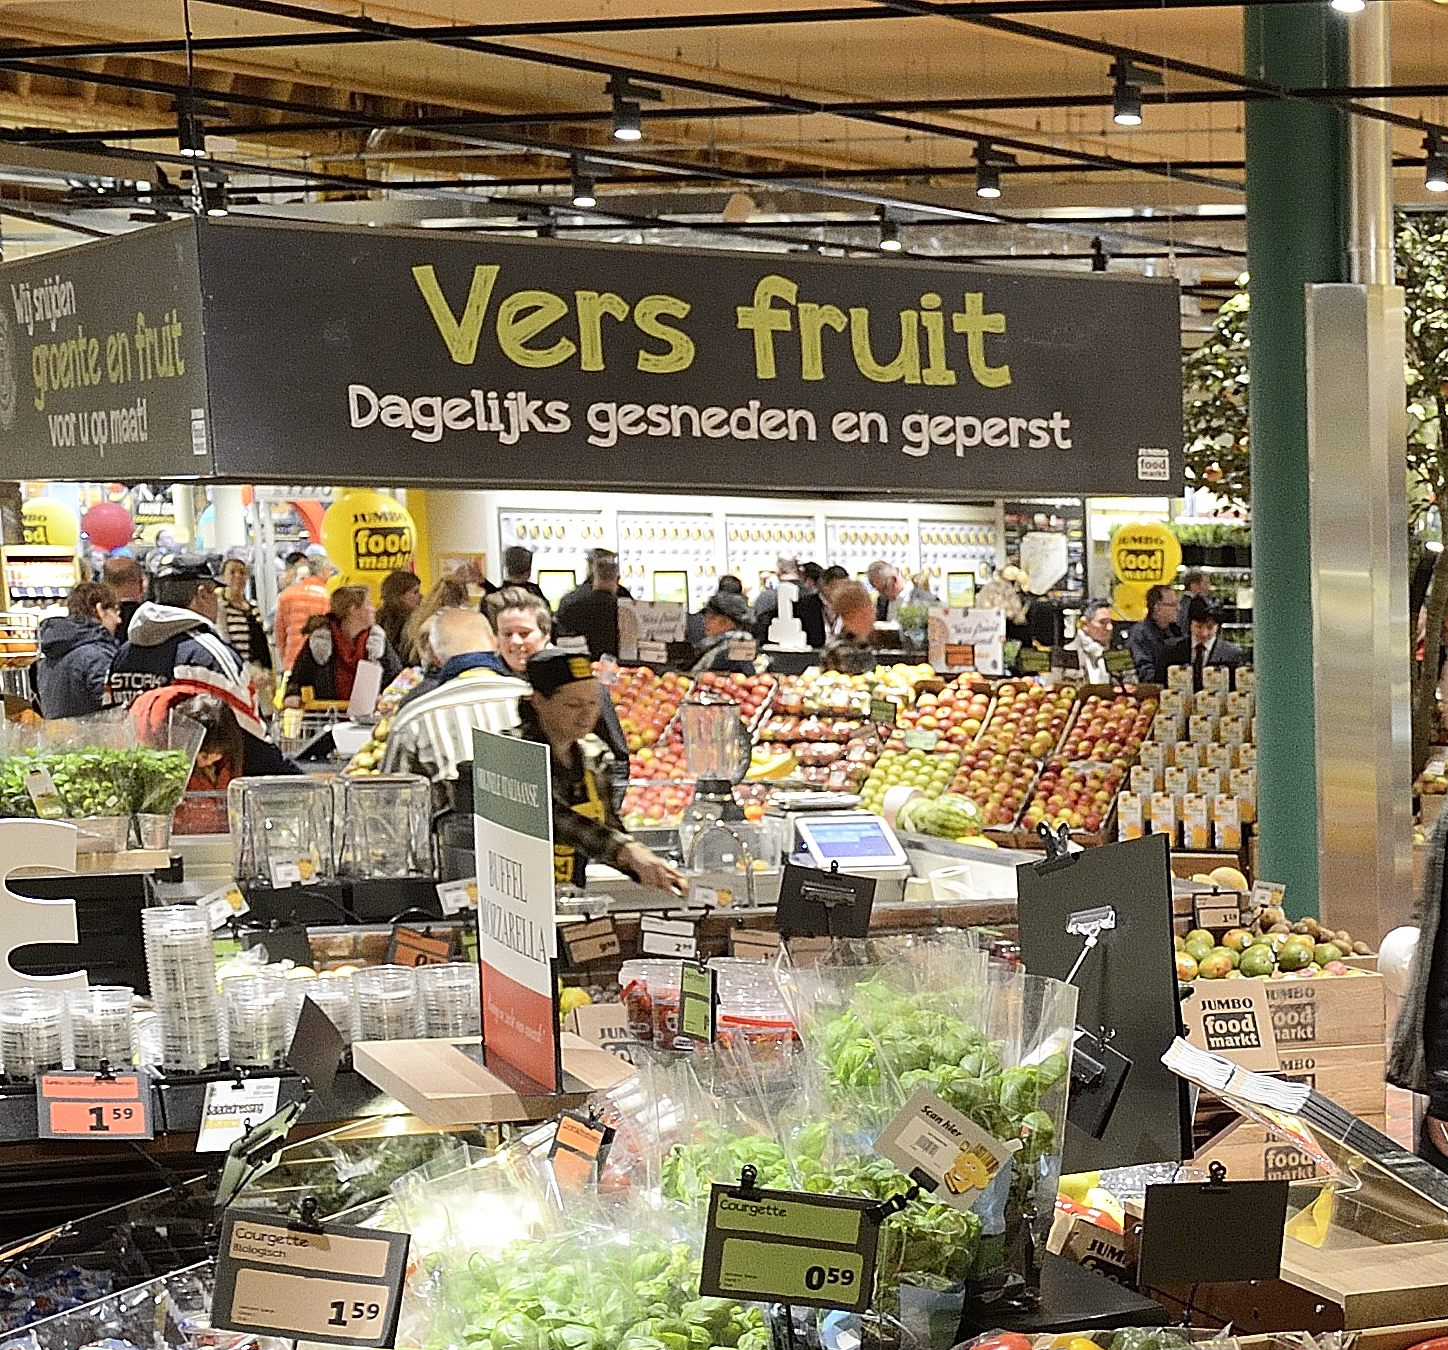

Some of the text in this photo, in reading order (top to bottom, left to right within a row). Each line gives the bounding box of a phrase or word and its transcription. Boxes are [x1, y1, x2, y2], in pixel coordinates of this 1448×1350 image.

[11, 275, 76, 336] Wij snijden
[412, 265, 1011, 388] Vers fruit
[32, 324, 102, 411] groente
[107, 332, 131, 384] en
[135, 308, 185, 381] fruit
[48, 412, 76, 447] voor
[79, 412, 89, 445] u
[91, 411, 107, 457] op
[110, 397, 147, 444] maat!
[349, 384, 1072, 457] Dagelijks gesneden en geperst
[356, 529, 412, 554] food
[1201, 998, 1253, 1010] JUMBO
[1205, 1014, 1255, 1034] food
[1209, 1034, 1259, 1047] markt
[921, 1105, 962, 1137] Scan hier
[720, 1200, 786, 1217] Courgette
[235, 1228, 308, 1247] Courgette
[234, 1243, 286, 1258] Biologisch
